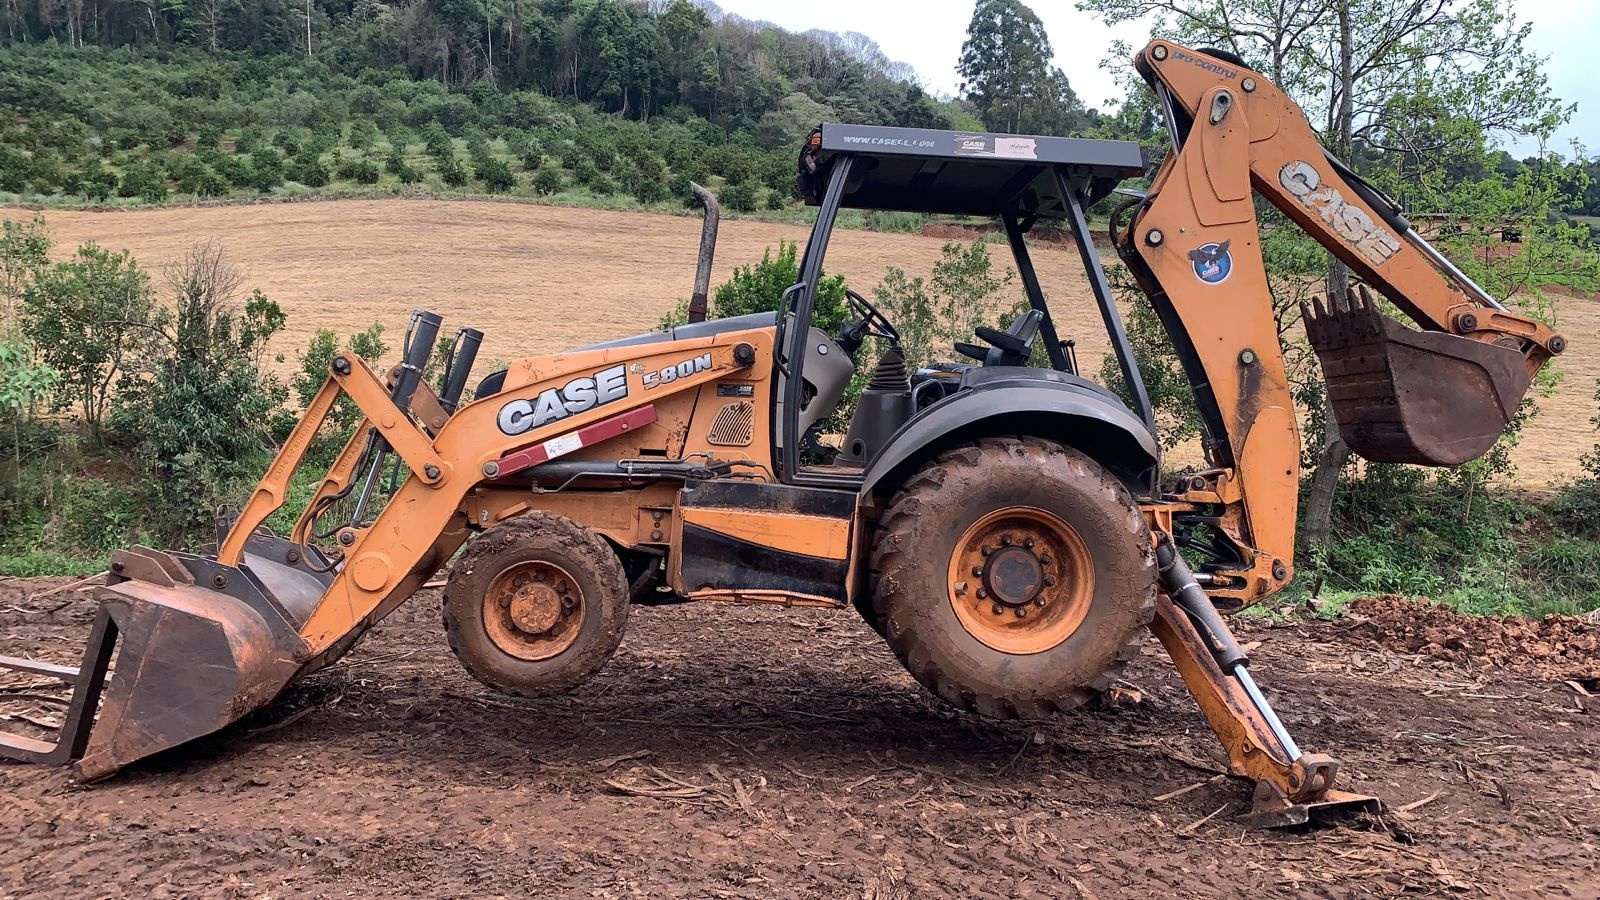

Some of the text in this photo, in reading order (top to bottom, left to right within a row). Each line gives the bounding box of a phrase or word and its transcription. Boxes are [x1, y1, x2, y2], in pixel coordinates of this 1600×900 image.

[1278, 159, 1401, 266] CASE
[497, 363, 629, 436] CASE
[642, 352, 712, 391] 580N
